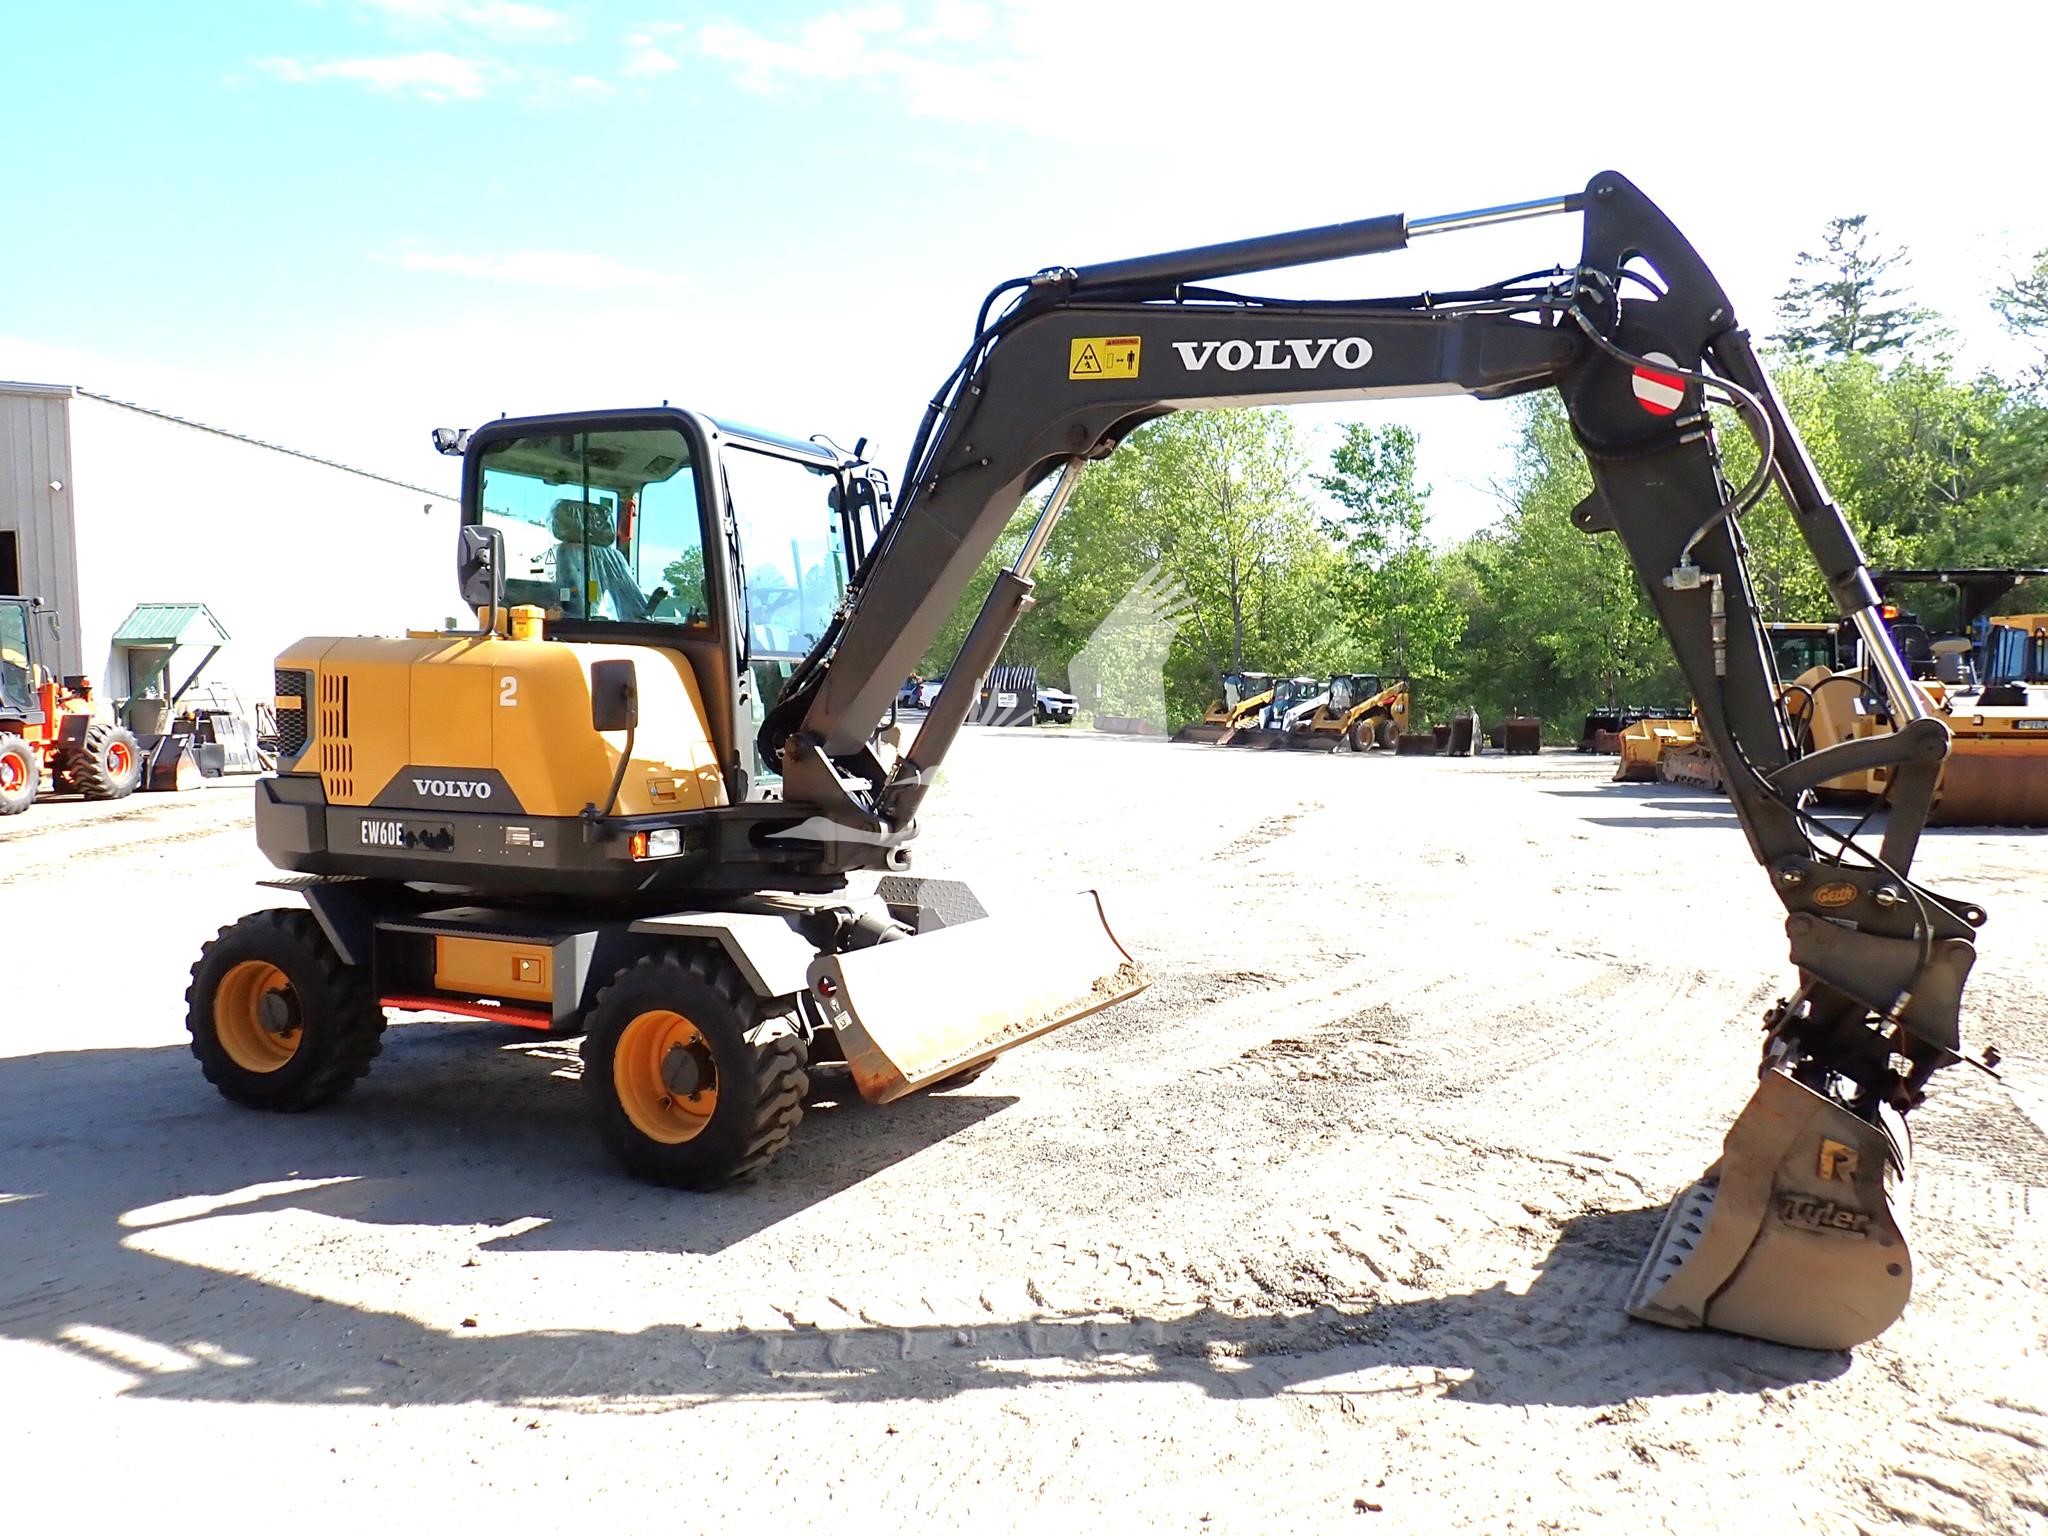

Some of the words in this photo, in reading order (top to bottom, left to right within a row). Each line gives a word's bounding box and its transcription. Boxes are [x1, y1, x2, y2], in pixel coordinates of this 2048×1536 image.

[1172, 337, 1373, 371] VOLVO
[500, 676, 517, 706] 2
[413, 779, 491, 799] VOLVO
[361, 820, 403, 845] EW60E
